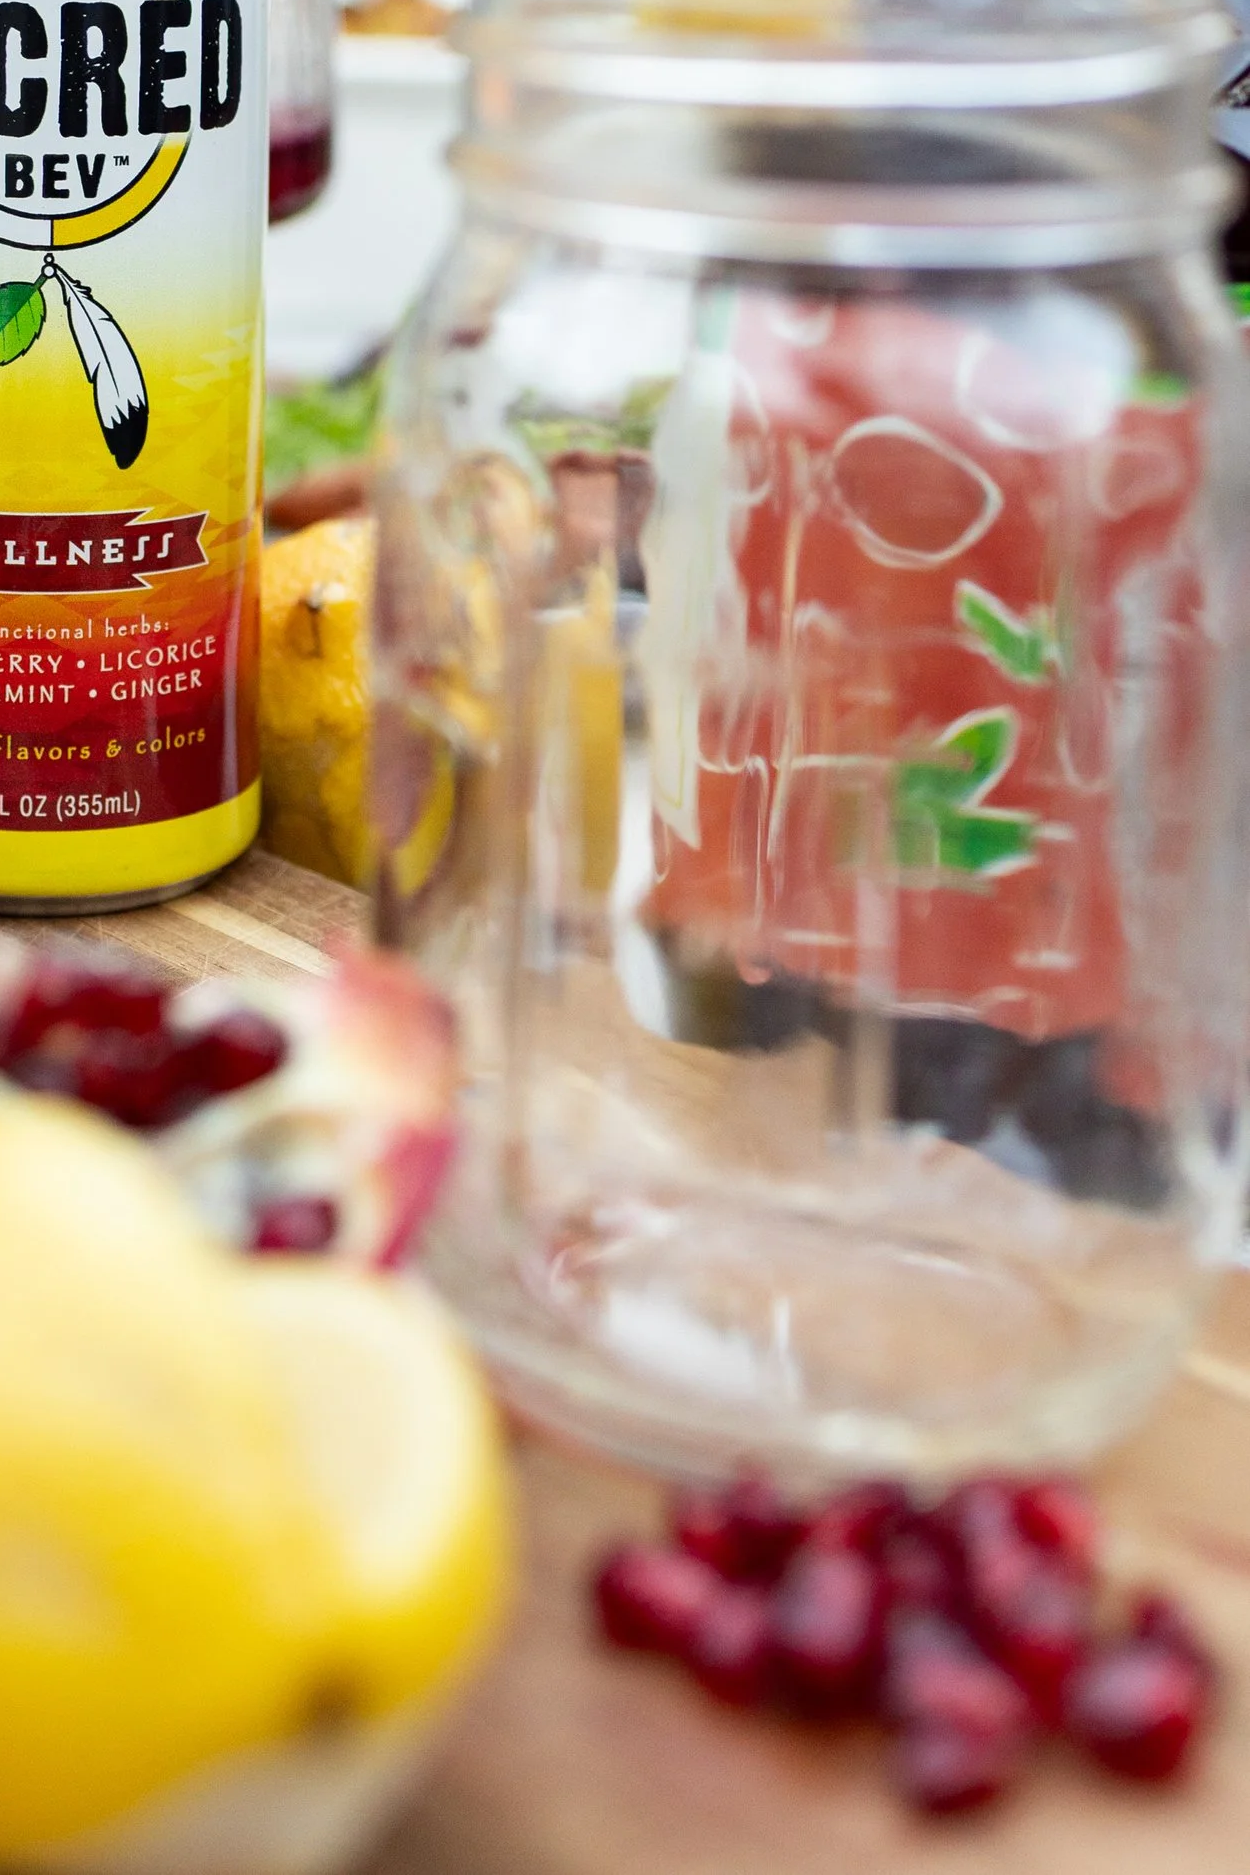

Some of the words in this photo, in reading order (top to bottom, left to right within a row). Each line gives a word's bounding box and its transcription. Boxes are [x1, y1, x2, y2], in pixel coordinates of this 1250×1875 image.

[5, 154, 105, 198] BEV
[105, 614, 169, 637] herbs:
[100, 636, 216, 672] LICORICE
[111, 669, 202, 701] GINGER
[106, 739, 122, 758] &
[136, 726, 206, 755] colors
[19, 795, 47, 817] OZ
[56, 790, 141, 822] (355mL)
